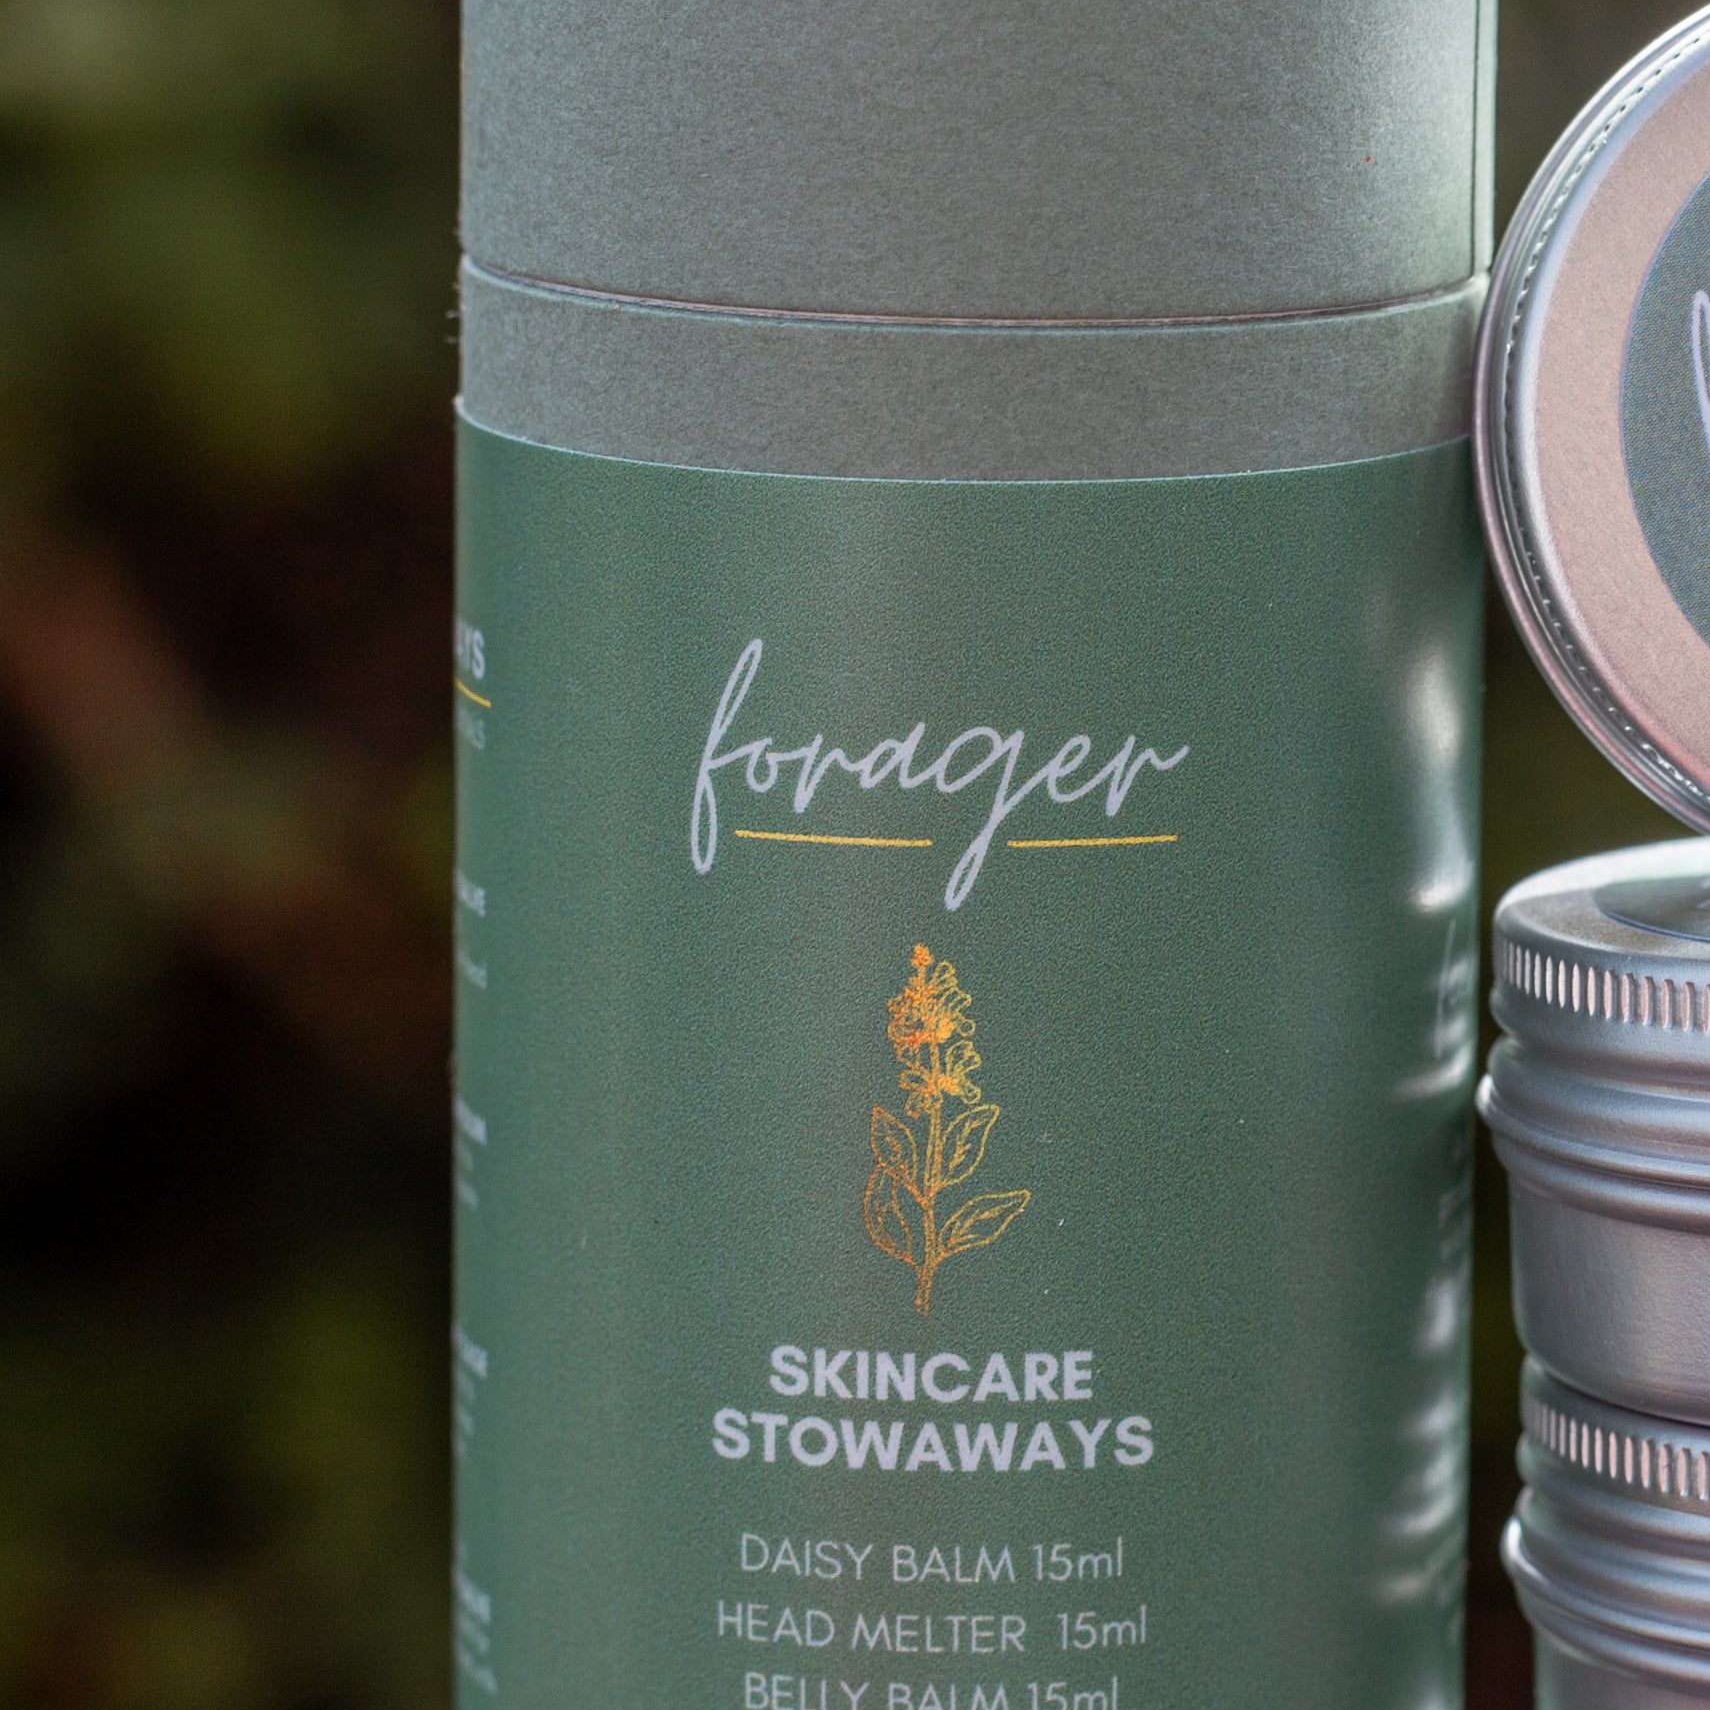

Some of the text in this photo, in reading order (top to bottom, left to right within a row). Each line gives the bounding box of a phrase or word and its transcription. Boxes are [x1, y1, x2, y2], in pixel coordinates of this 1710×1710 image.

[690, 639, 1190, 911] forager
[769, 1344, 1095, 1402] SKINCARE
[712, 1408, 1154, 1472] STOWAWAYS
[741, 1533, 1123, 1582] DAISY BALM 15ml
[717, 1601, 1147, 1653] HEAD MELTER 15ml
